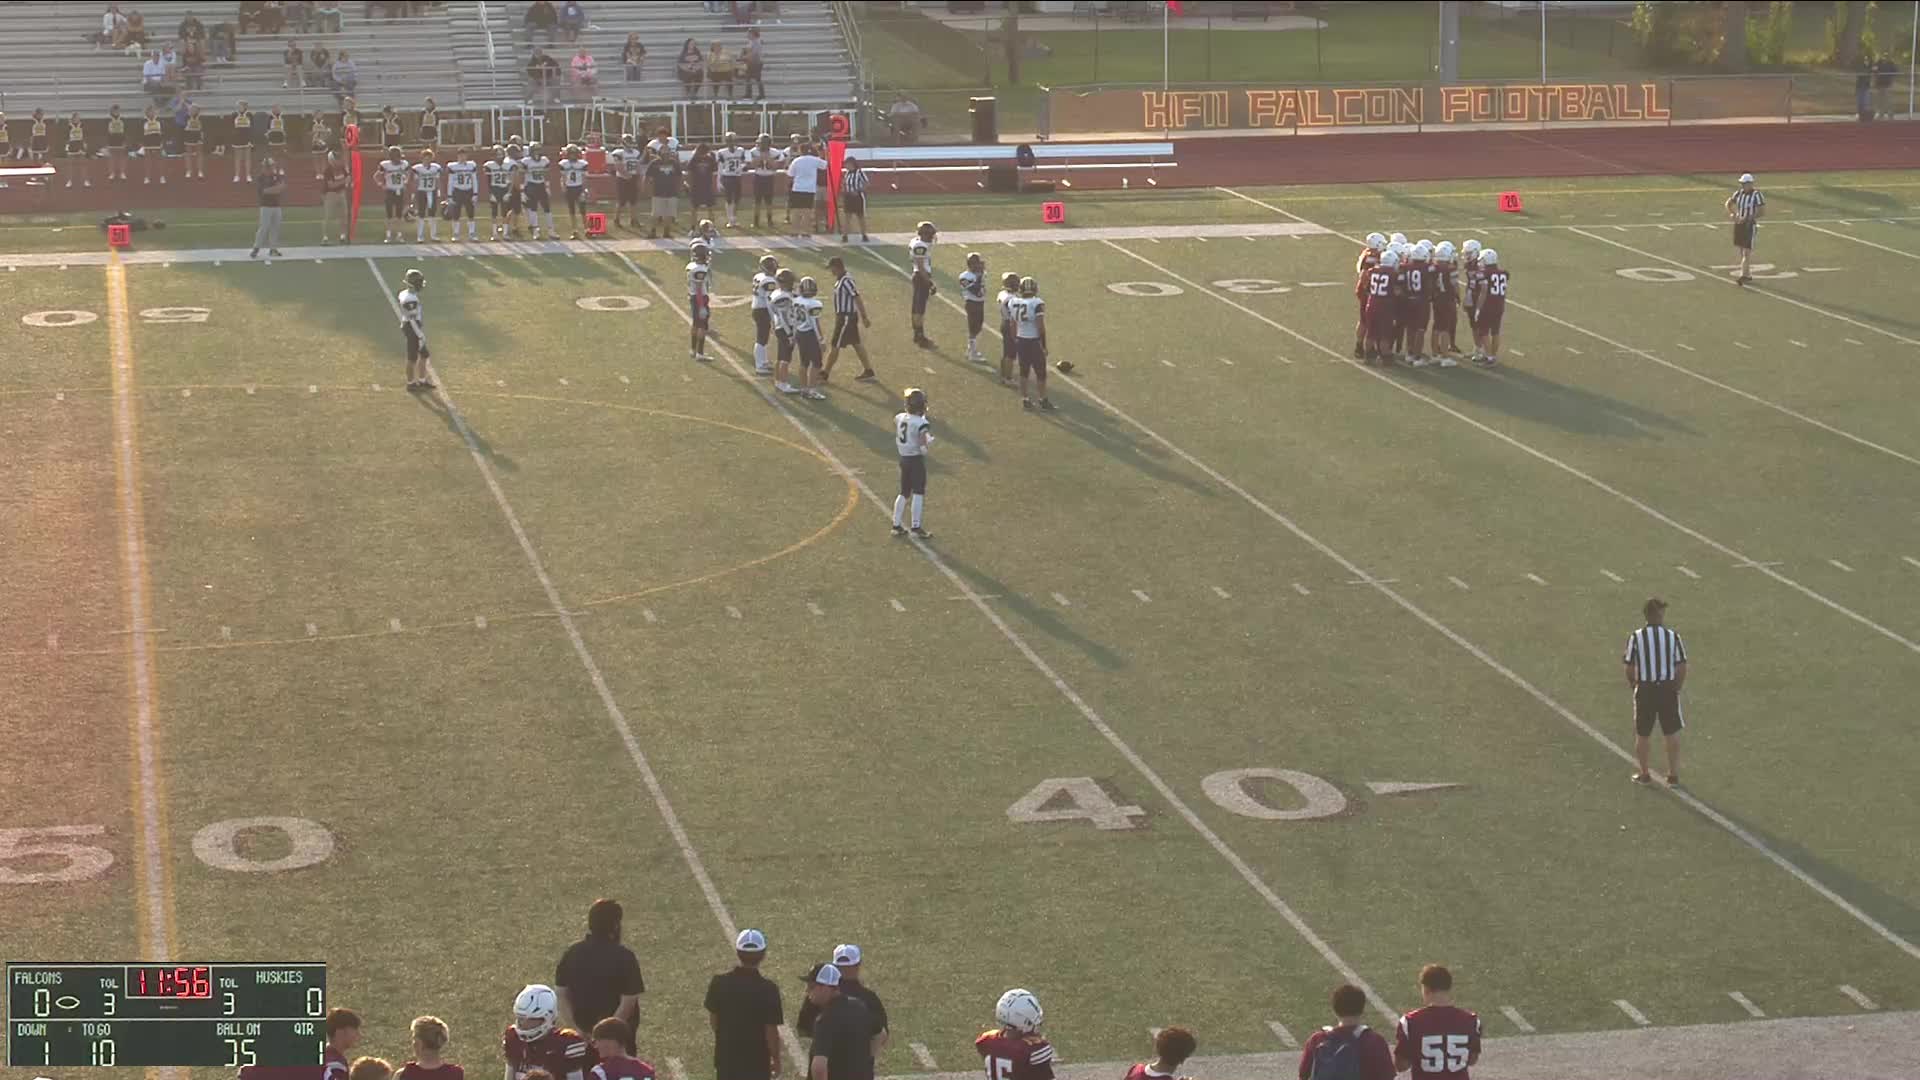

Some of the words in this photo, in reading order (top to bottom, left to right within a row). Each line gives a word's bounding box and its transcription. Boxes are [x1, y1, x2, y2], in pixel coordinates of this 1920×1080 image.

[1245, 87, 1423, 126] FALCON
[1440, 84, 1671, 122] FOOTBALL
[1370, 273, 1389, 296] 52
[1490, 273, 1507, 296] 32
[1013, 303, 1028, 321] 72
[900, 421, 909, 444] 3
[1421, 1034, 1469, 1073] 55
